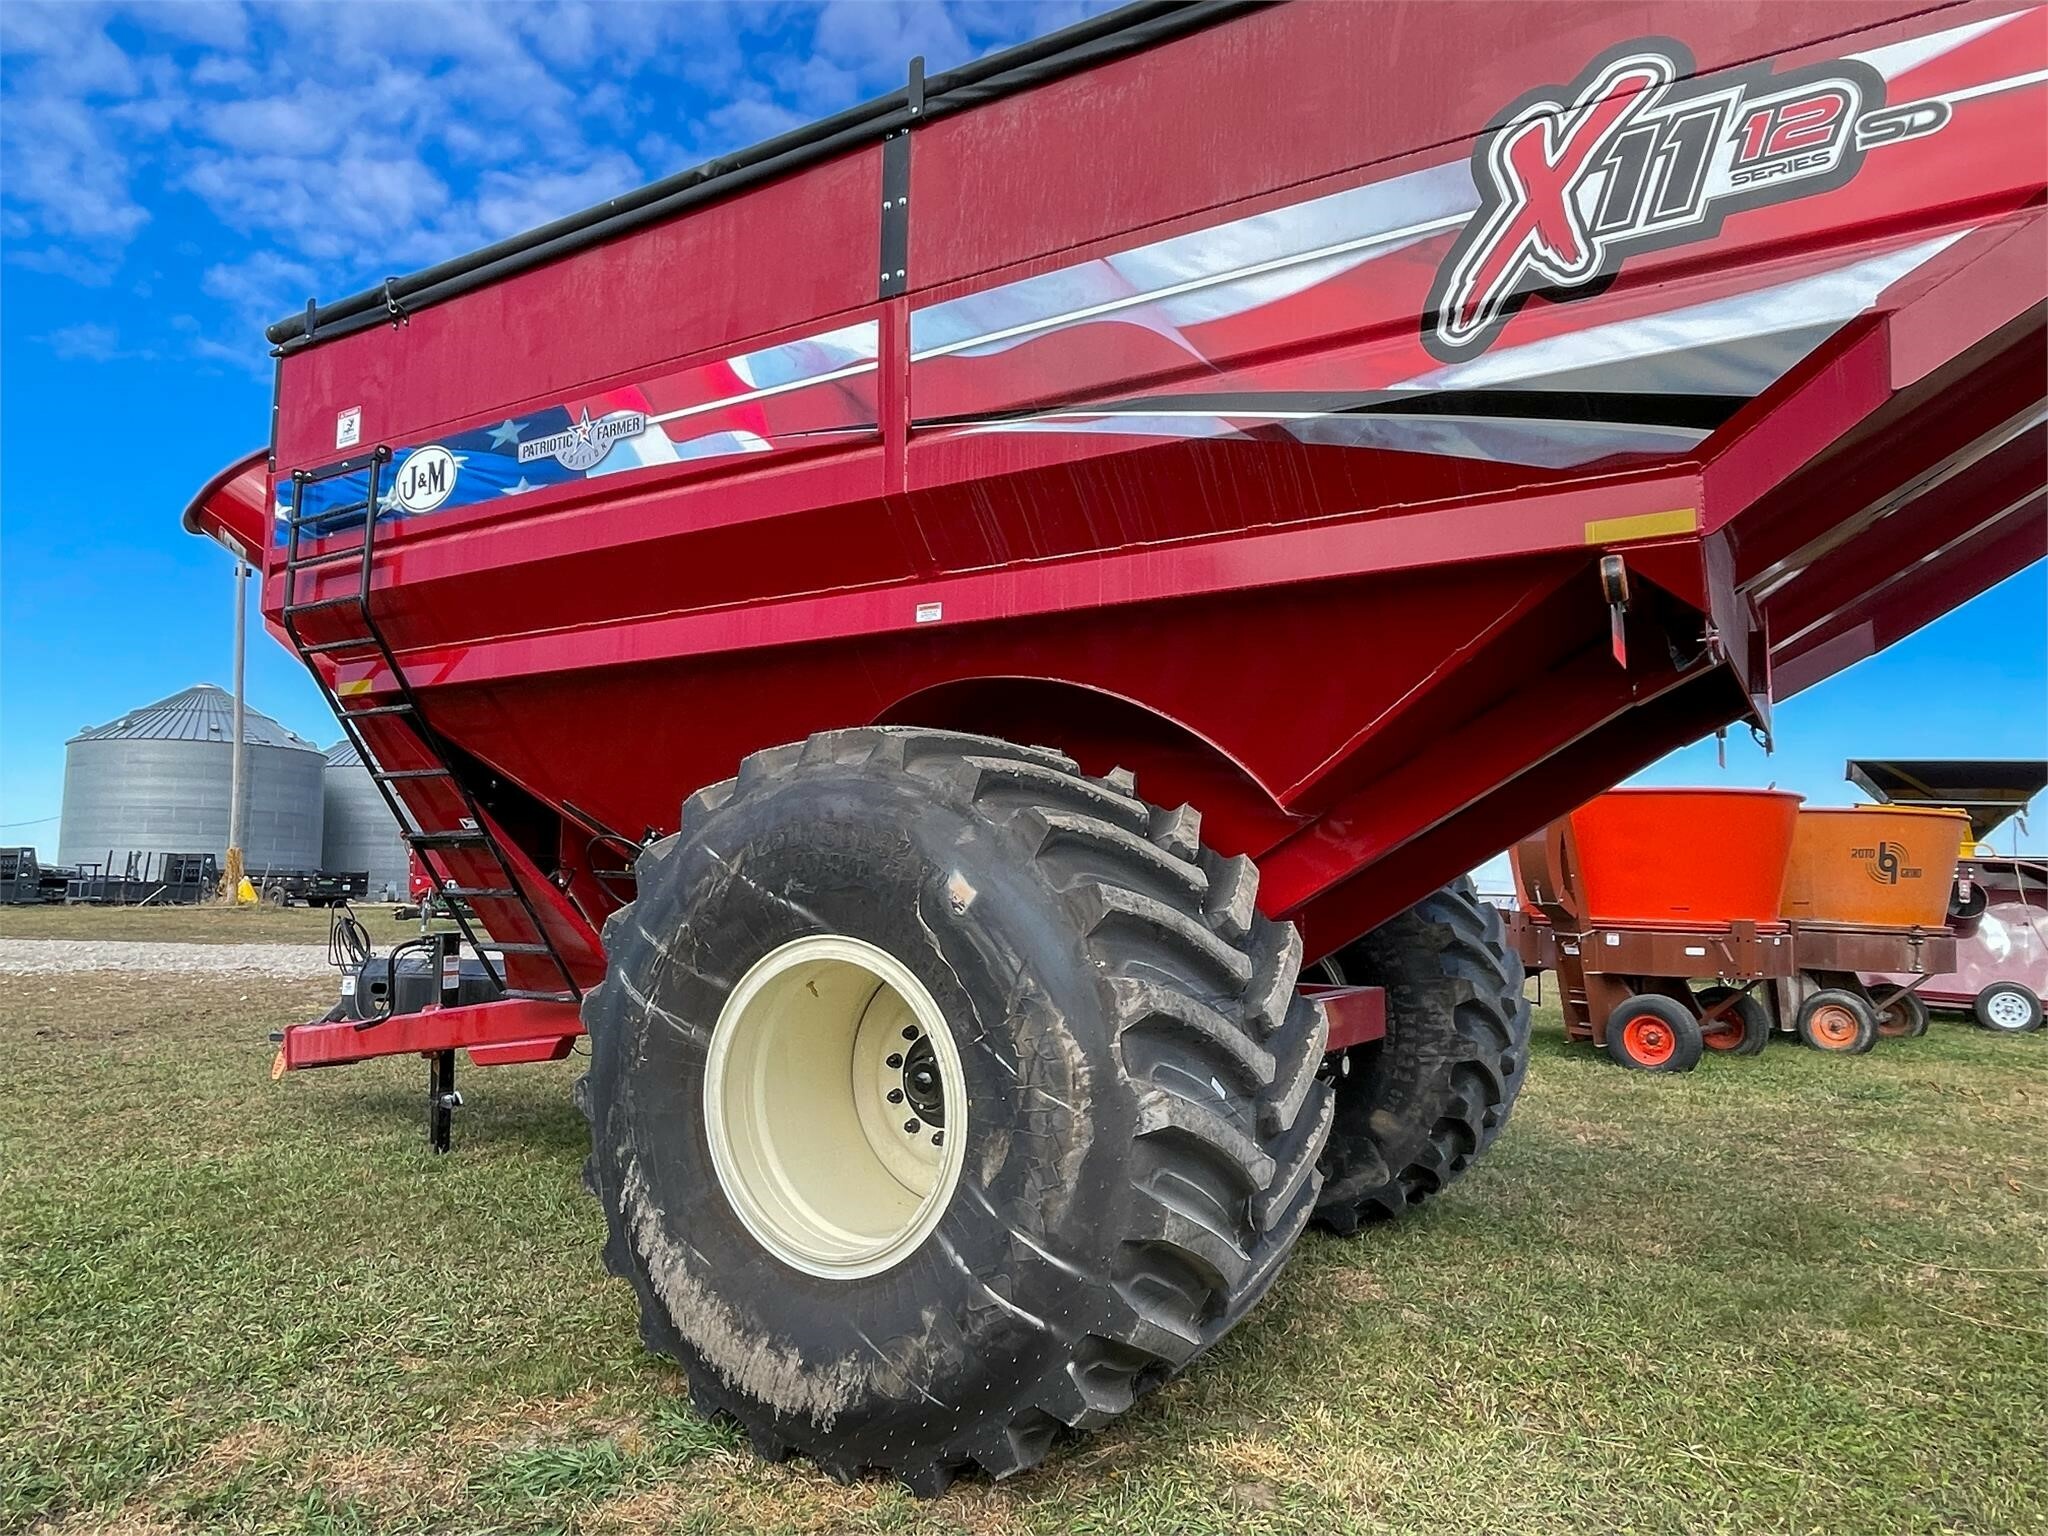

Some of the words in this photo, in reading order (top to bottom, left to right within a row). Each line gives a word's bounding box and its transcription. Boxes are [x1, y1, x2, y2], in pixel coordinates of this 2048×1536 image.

[1855, 100, 1953, 151] SD
[1731, 151, 1831, 187] SERIES
[522, 433, 574, 459] PATRIOTIC
[597, 416, 640, 441] FARMER
[561, 443, 608, 466] EDITION
[402, 457, 446, 500] J&M
